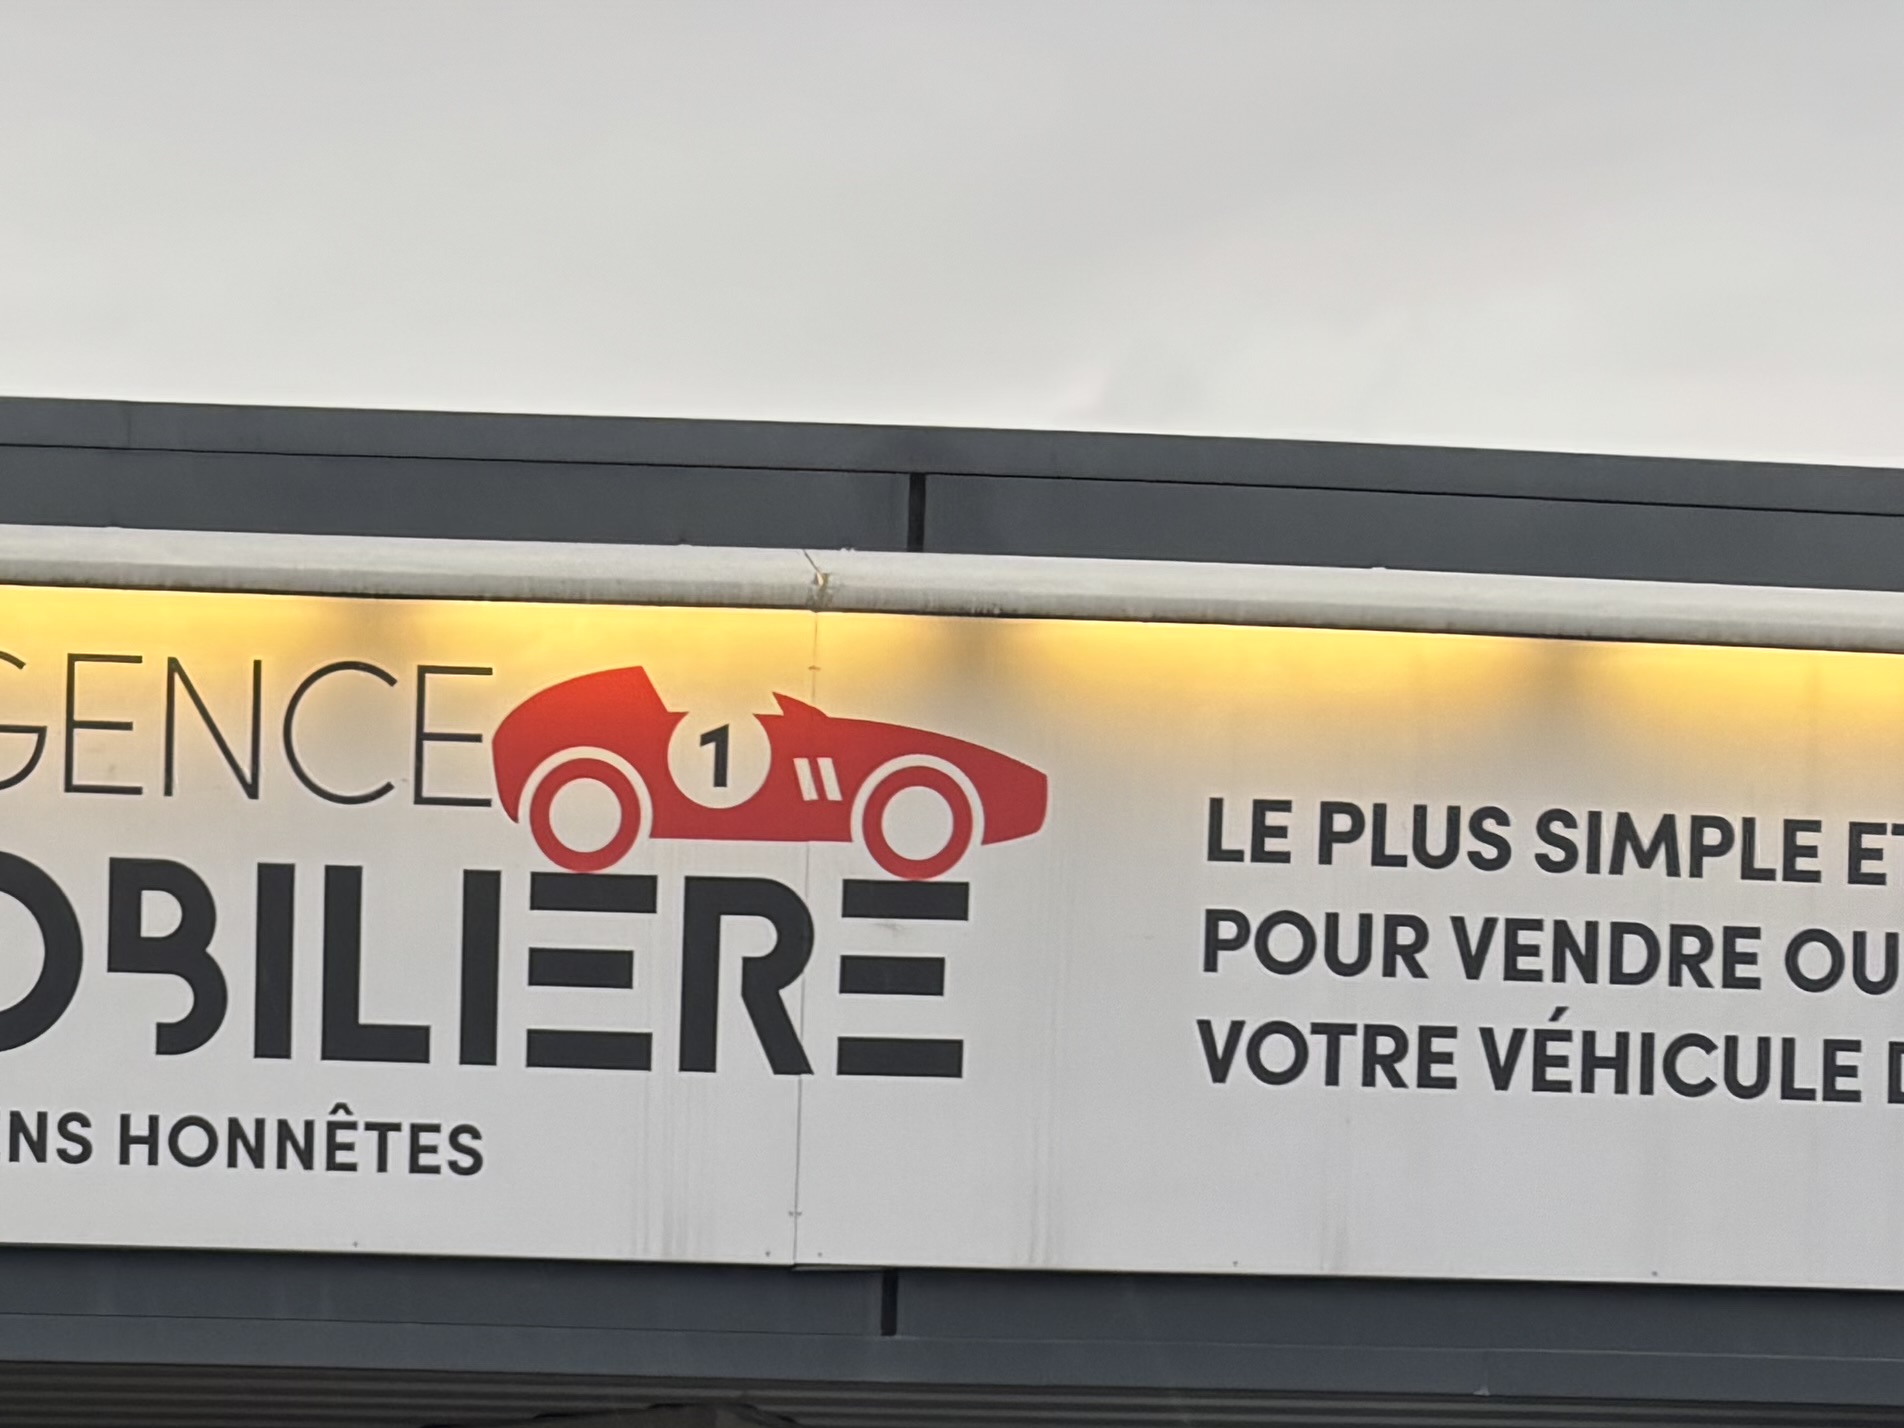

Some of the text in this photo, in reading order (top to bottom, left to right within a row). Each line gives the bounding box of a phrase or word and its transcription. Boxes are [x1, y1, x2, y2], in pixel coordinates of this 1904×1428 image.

[698, 722, 730, 789] 1
[1205, 796, 1292, 865] LE
[1317, 800, 1513, 872] PLUS
[1533, 808, 1823, 884] SIMPLE
[1202, 908, 1900, 996] POUR VENDRE OU
[1196, 1018, 1458, 1090] VOTRE
[1478, 1005, 1863, 1104] VÉHICULE
[118, 1102, 484, 1178] HONNÊTES
